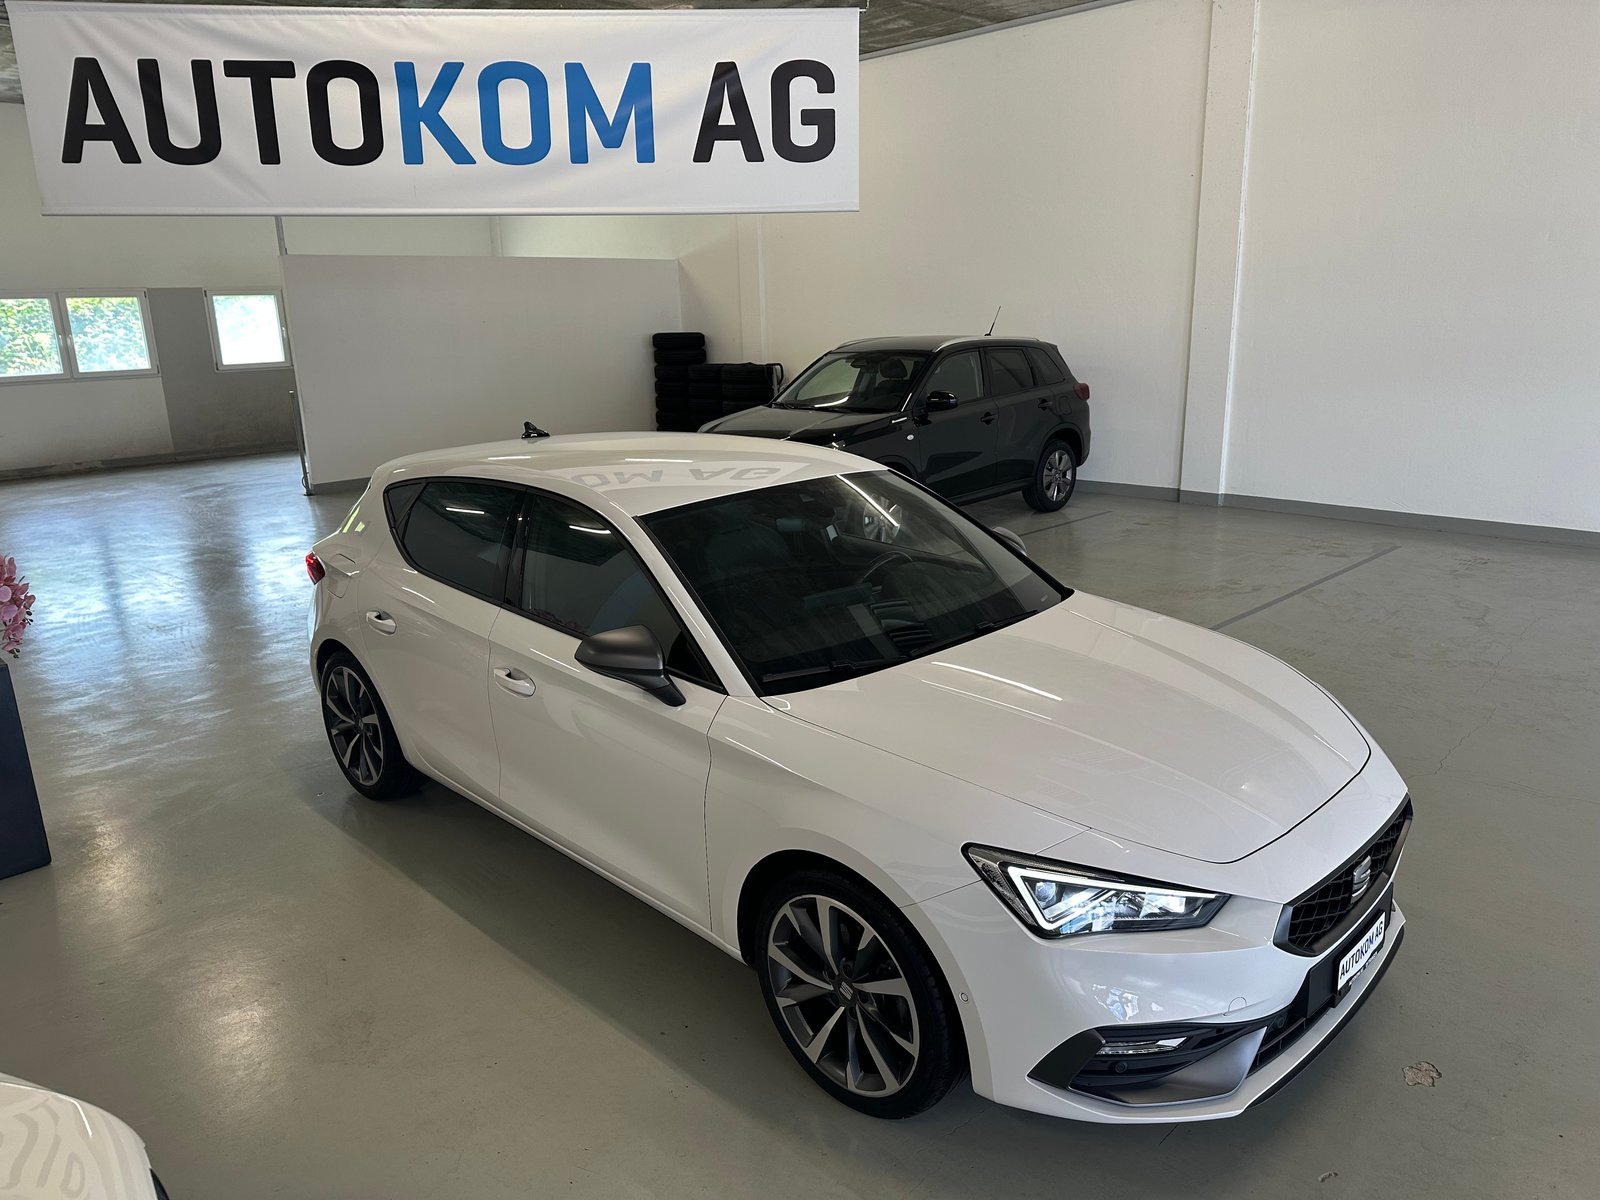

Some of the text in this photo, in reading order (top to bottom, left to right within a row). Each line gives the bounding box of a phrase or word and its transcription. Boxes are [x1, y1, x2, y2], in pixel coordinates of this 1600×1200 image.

[61, 57, 837, 167] AUTOKOM AG
[1340, 920, 1384, 979] AUTOKOM AG
